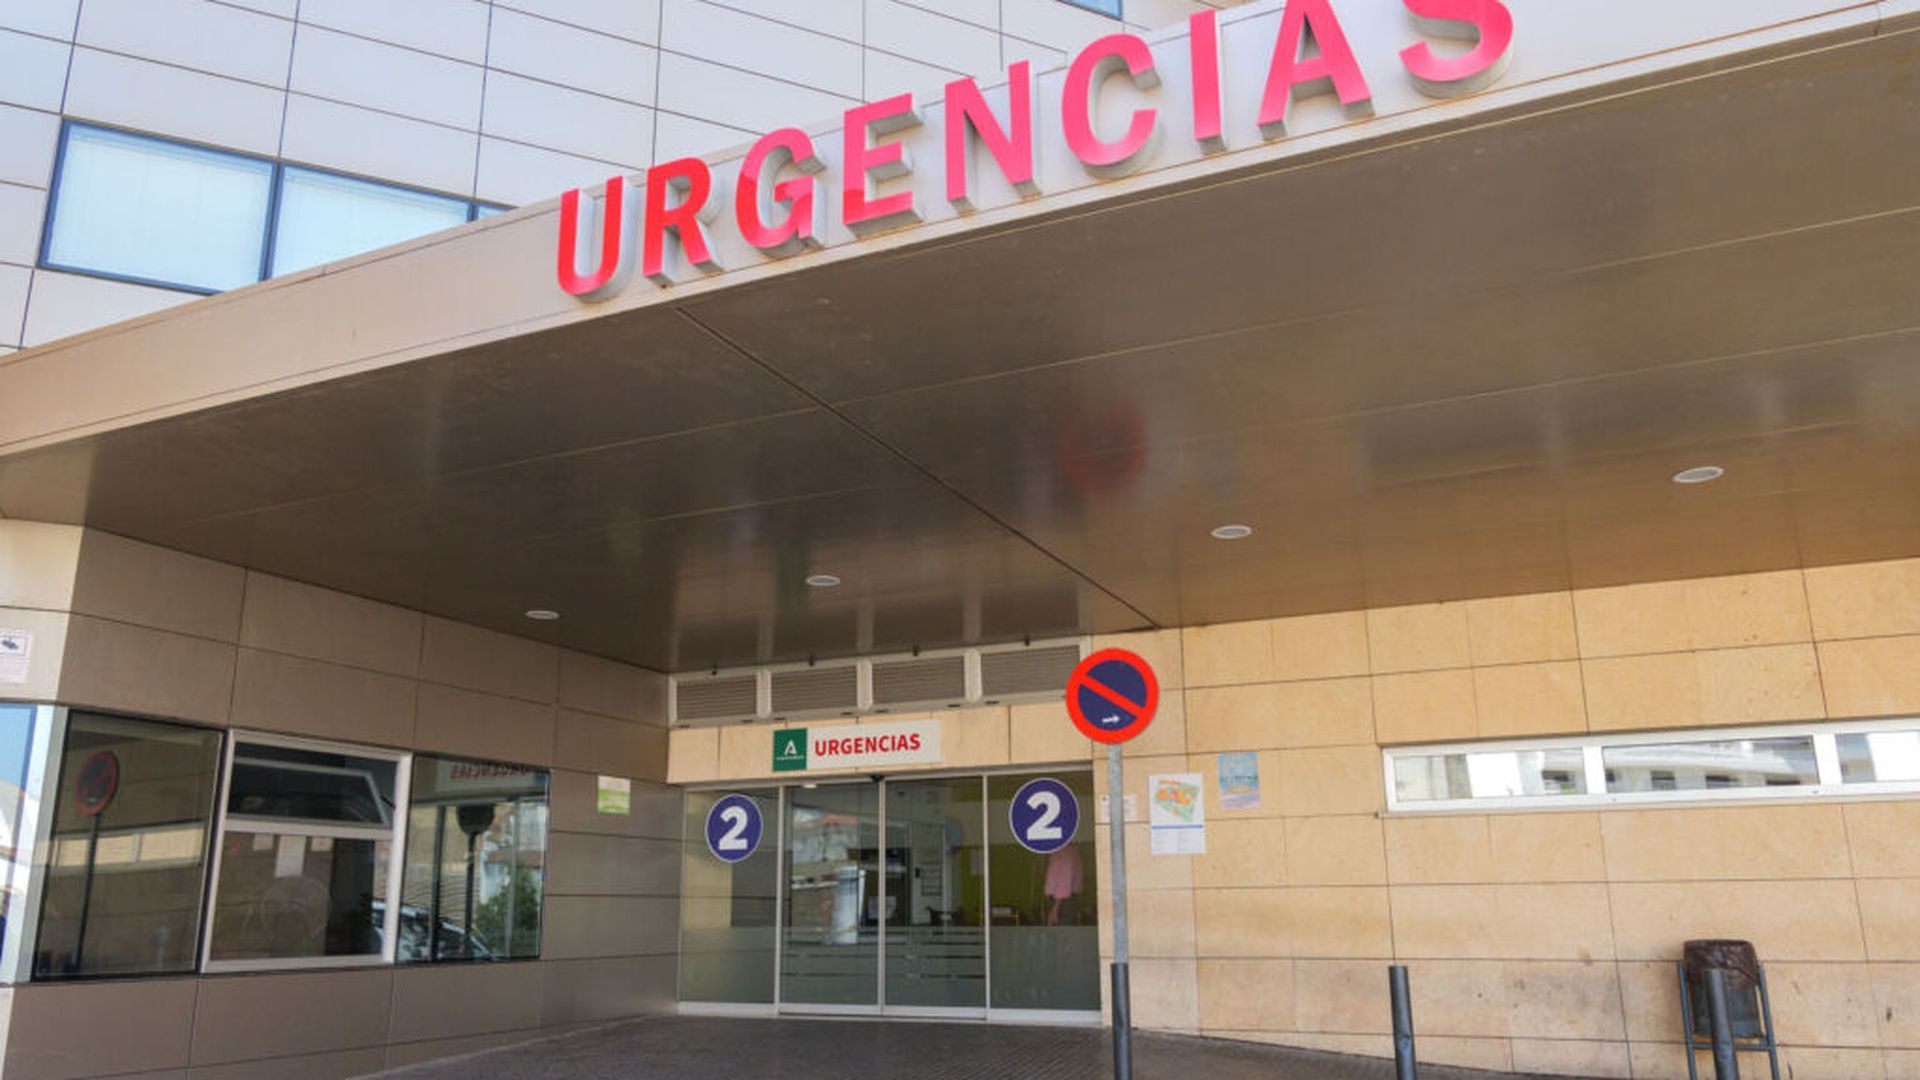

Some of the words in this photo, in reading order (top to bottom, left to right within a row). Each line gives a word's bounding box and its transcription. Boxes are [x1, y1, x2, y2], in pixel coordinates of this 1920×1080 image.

[556, 0, 1514, 300] URGENCIAS
[814, 733, 921, 757] URGENCIAS
[718, 806, 748, 851] 2
[1026, 791, 1063, 841] 2
